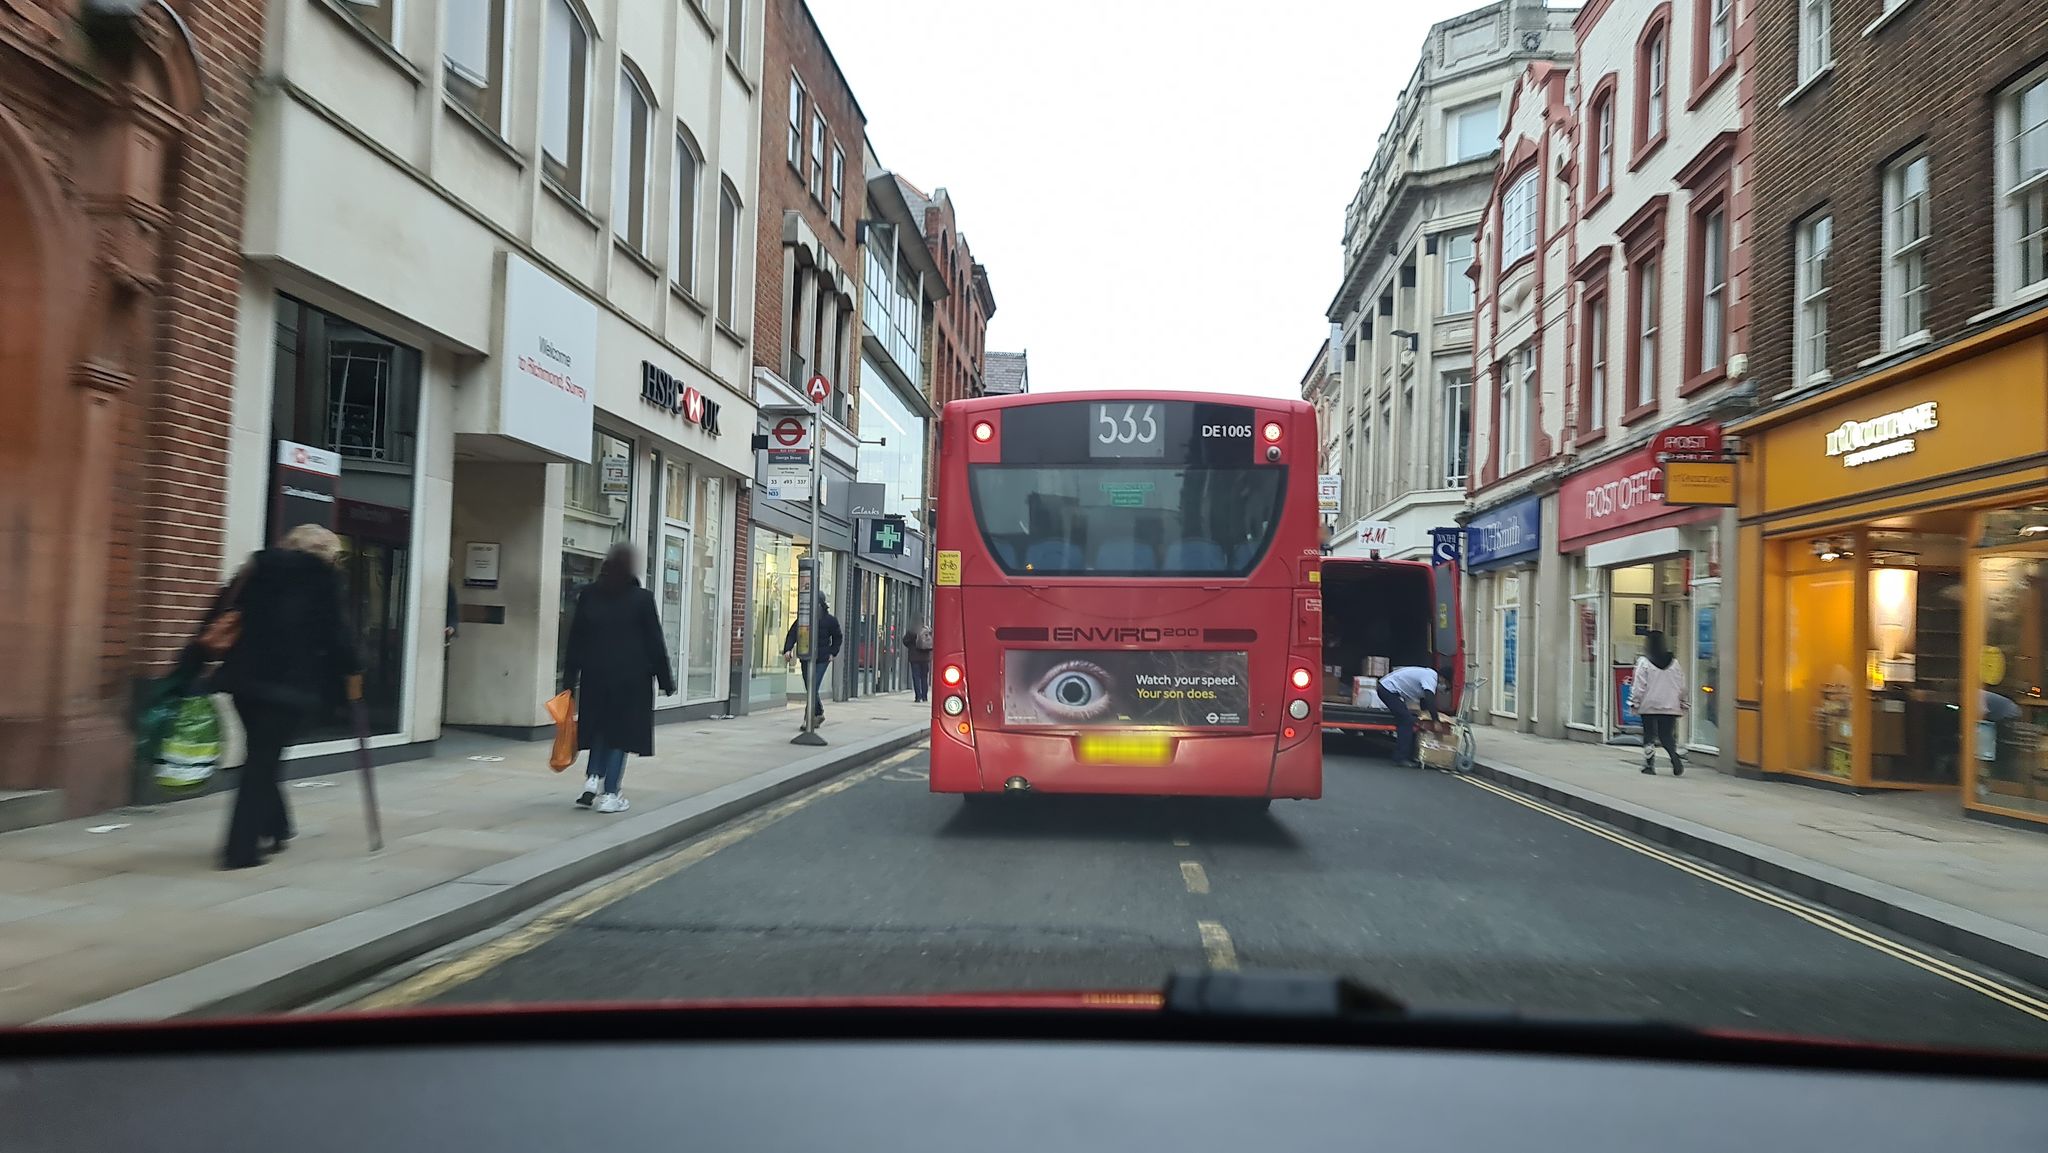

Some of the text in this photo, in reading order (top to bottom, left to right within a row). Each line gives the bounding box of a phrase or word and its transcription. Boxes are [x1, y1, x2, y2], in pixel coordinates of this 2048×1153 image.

[539, 335, 571, 367] Welcome
[518, 354, 526, 371] to
[565, 375, 587, 403] Surrey
[810, 378, 826, 396] A
[640, 360, 722, 436] HSBC UK
[1202, 425, 1252, 438] DE1005
[1585, 467, 1665, 520] POST OFFIC
[851, 505, 880, 515] Clarks
[1136, 674, 1239, 688] Watch your speed.
[1136, 688, 1217, 699] Your son does.
